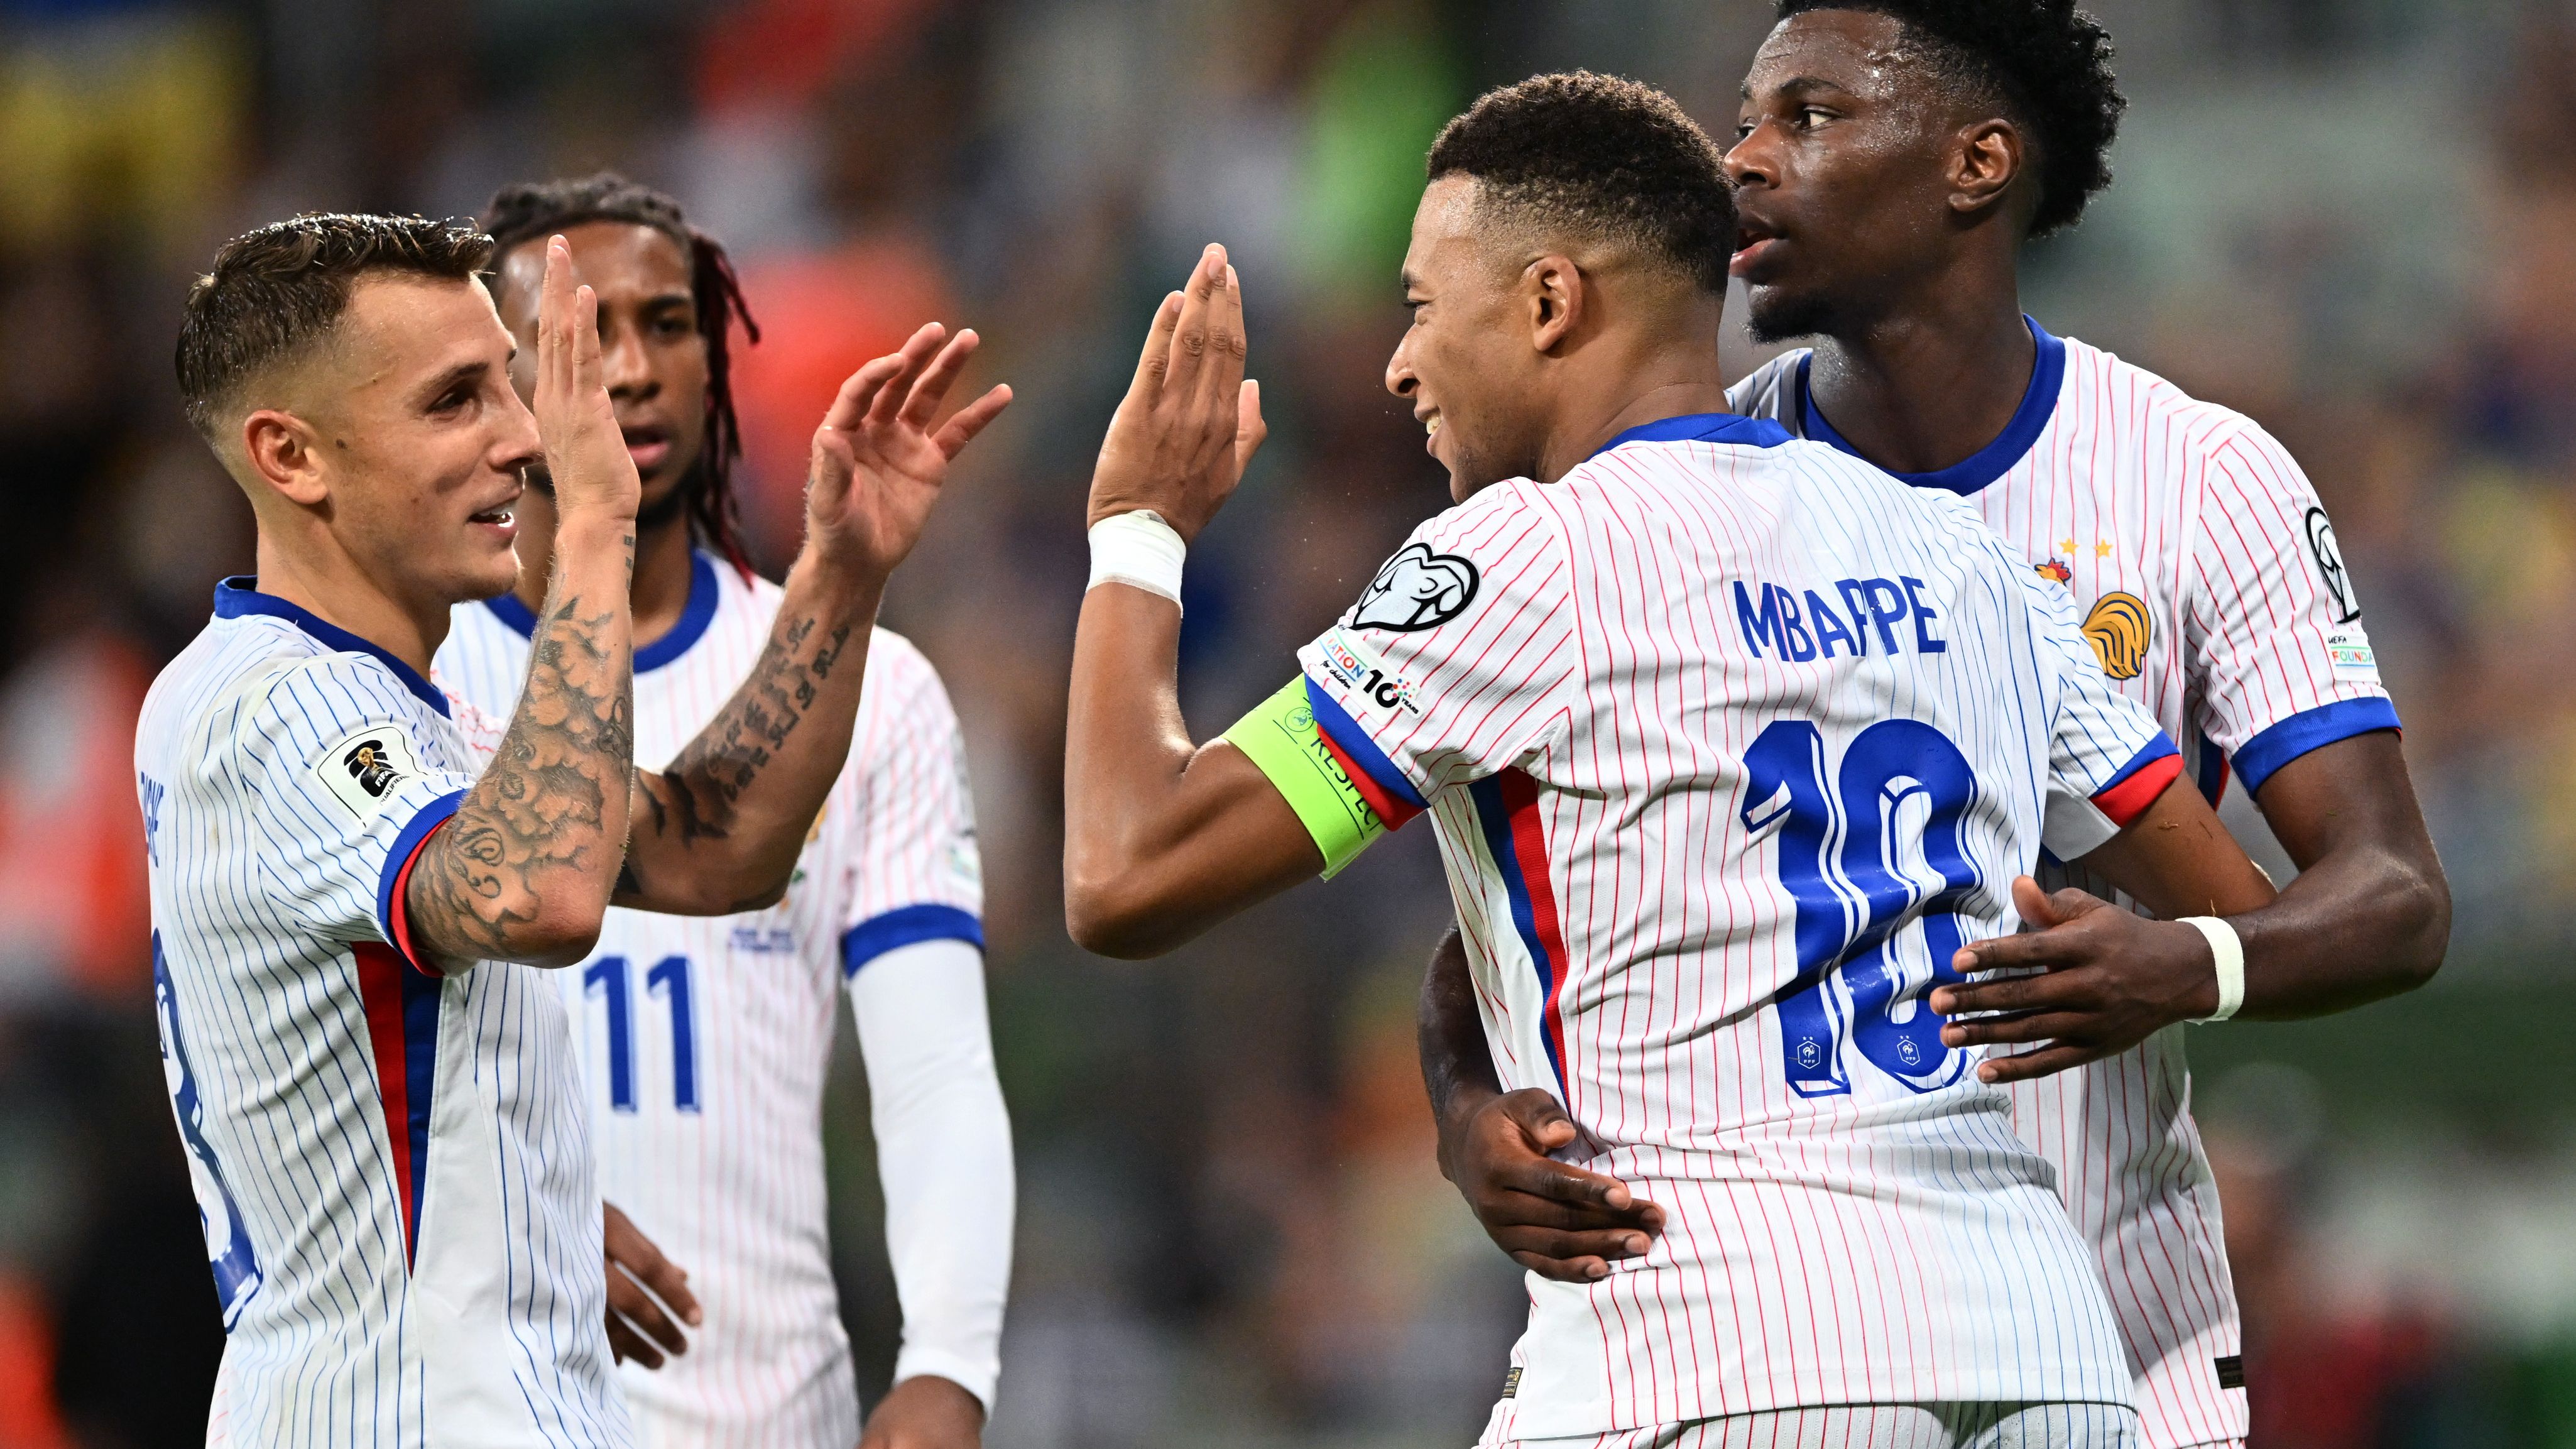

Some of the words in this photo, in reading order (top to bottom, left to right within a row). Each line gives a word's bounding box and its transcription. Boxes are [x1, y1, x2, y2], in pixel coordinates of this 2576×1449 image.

[1733, 575, 1946, 662] MBAPPE
[2328, 635, 2347, 644] UEFA
[1320, 660, 1330, 669] for
[1329, 669, 1351, 690] children
[1363, 669, 1400, 708] 10
[1401, 697, 1419, 714] YEARS
[375, 770, 392, 787] FIFA
[1740, 719, 1982, 1098] 10
[583, 954, 701, 1115] 11
